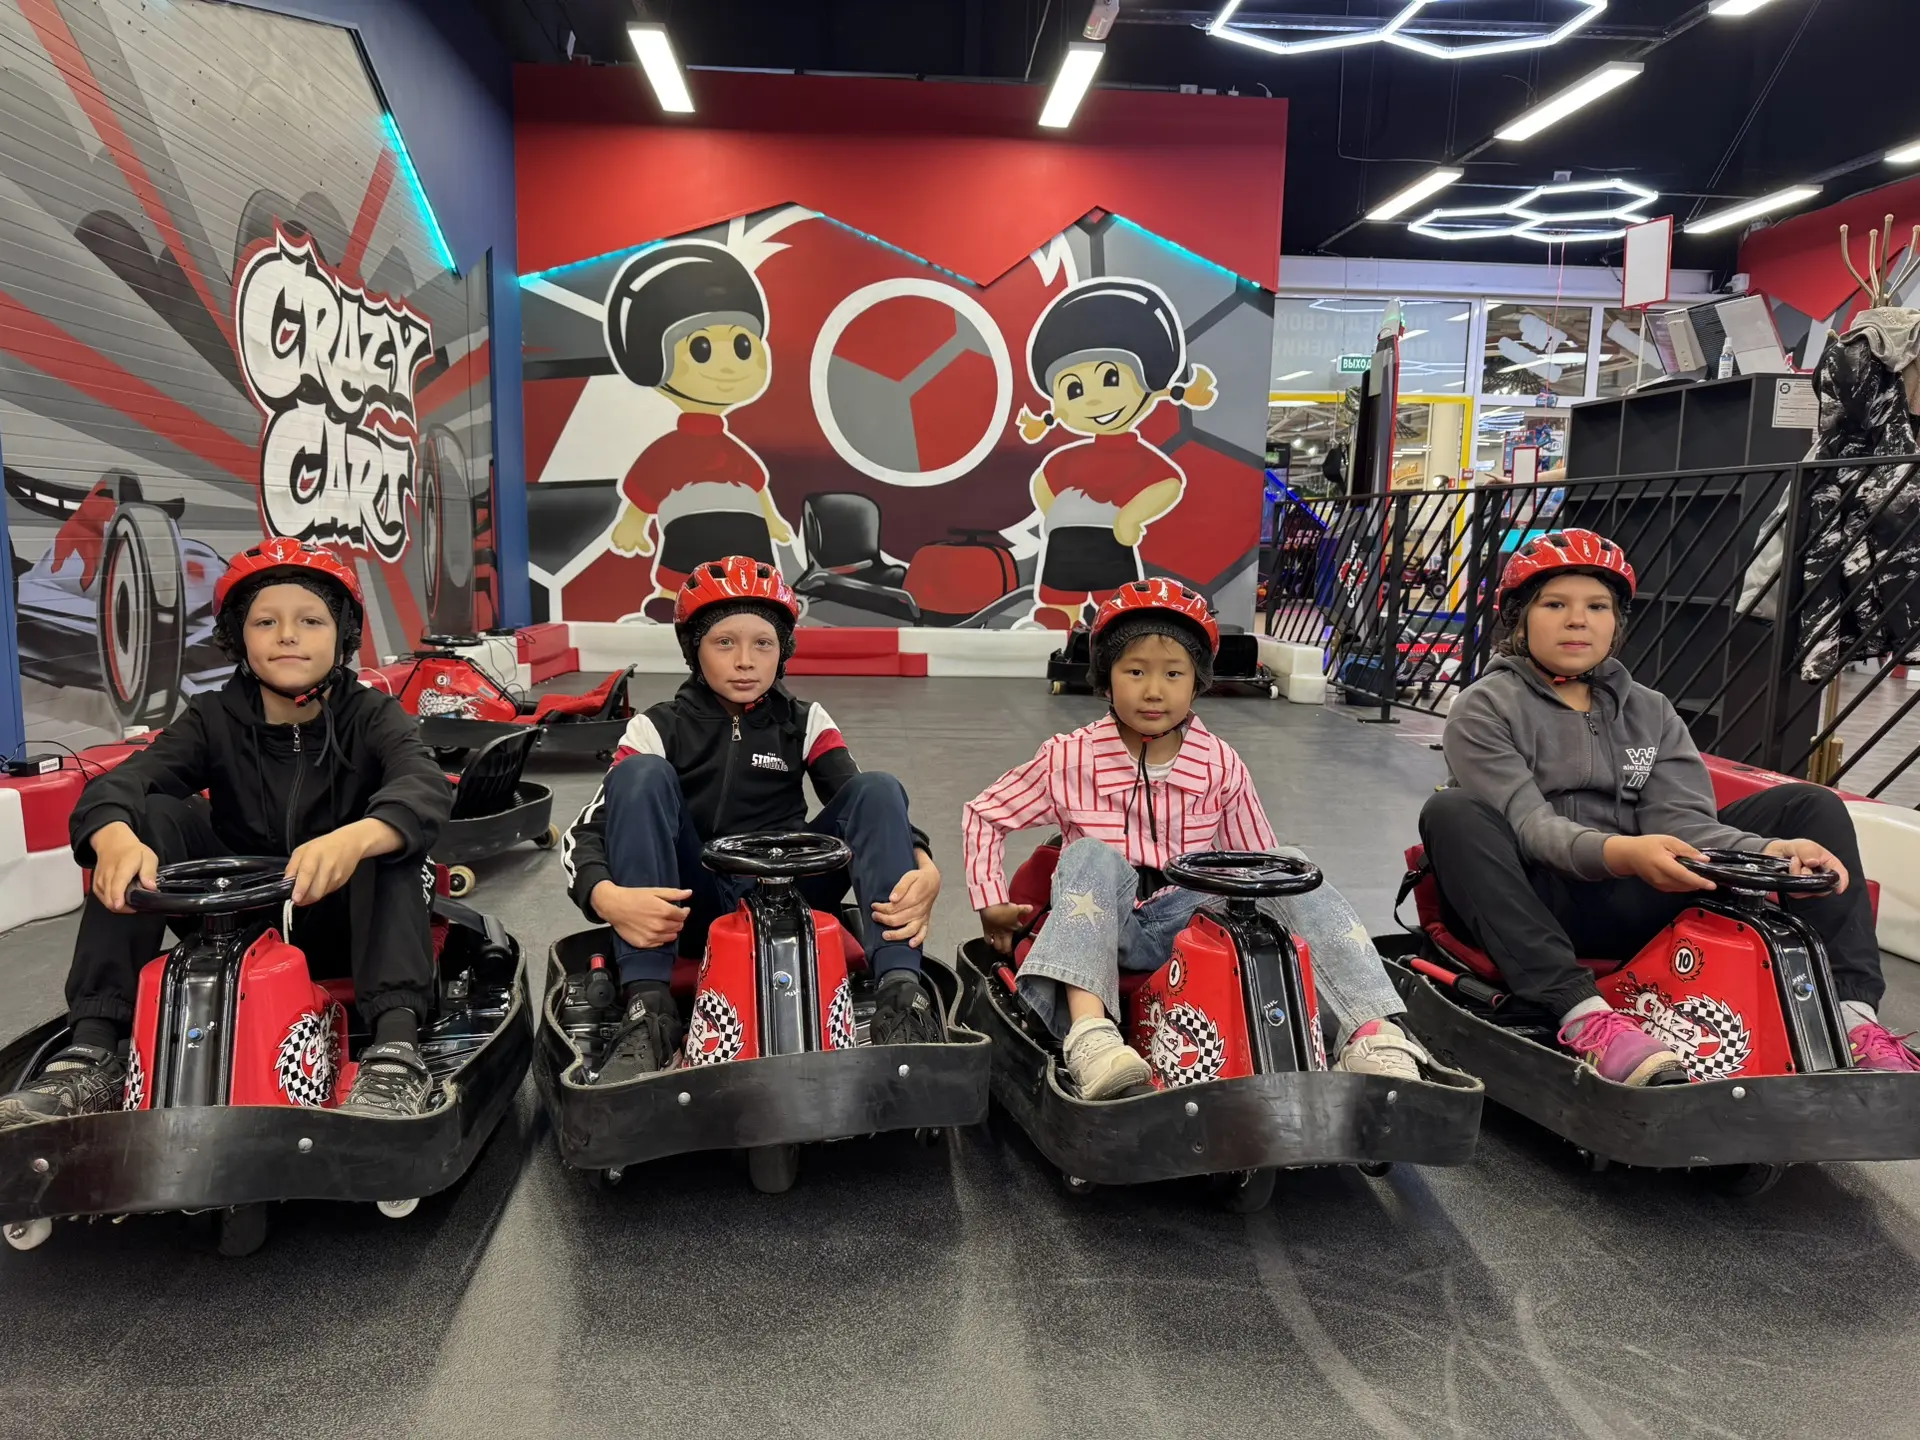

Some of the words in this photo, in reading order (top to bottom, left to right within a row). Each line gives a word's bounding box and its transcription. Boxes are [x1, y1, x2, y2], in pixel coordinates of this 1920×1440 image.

[243, 250, 427, 414] CRAZY
[1343, 358, 1372, 370] ВЫХОД
[263, 399, 409, 544] CART
[1678, 953, 1692, 970] 10
[1636, 991, 1721, 1051] CRAZY
